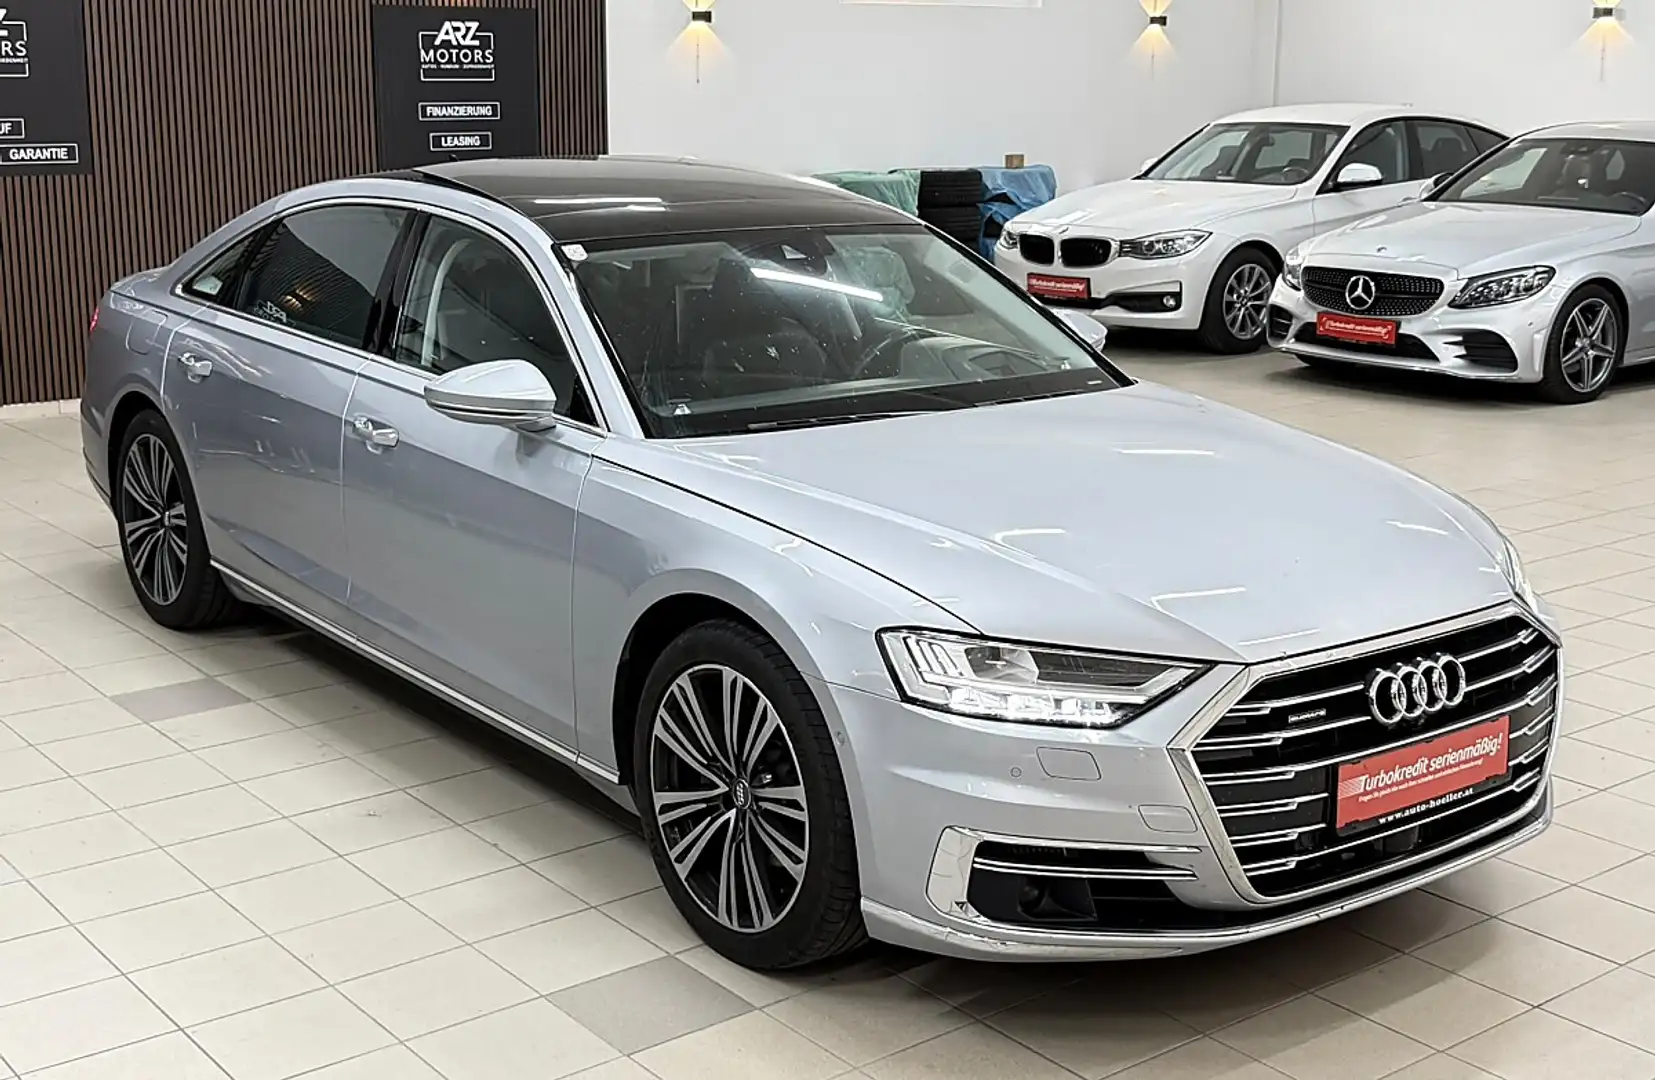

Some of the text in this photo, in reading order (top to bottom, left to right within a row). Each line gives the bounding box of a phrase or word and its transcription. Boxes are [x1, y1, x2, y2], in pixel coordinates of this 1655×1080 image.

[434, 20, 480, 46] ARZ
[420, 48, 494, 63] MOTORS
[426, 105, 492, 117] FINANZIERUNG
[441, 135, 481, 148] LEASING
[9, 147, 69, 160] GARANTIE
[1359, 758, 1429, 793] Turbokredit
[1429, 732, 1503, 770] serienmäßig!
[1378, 787, 1474, 824] www.auto-hoeller.at
